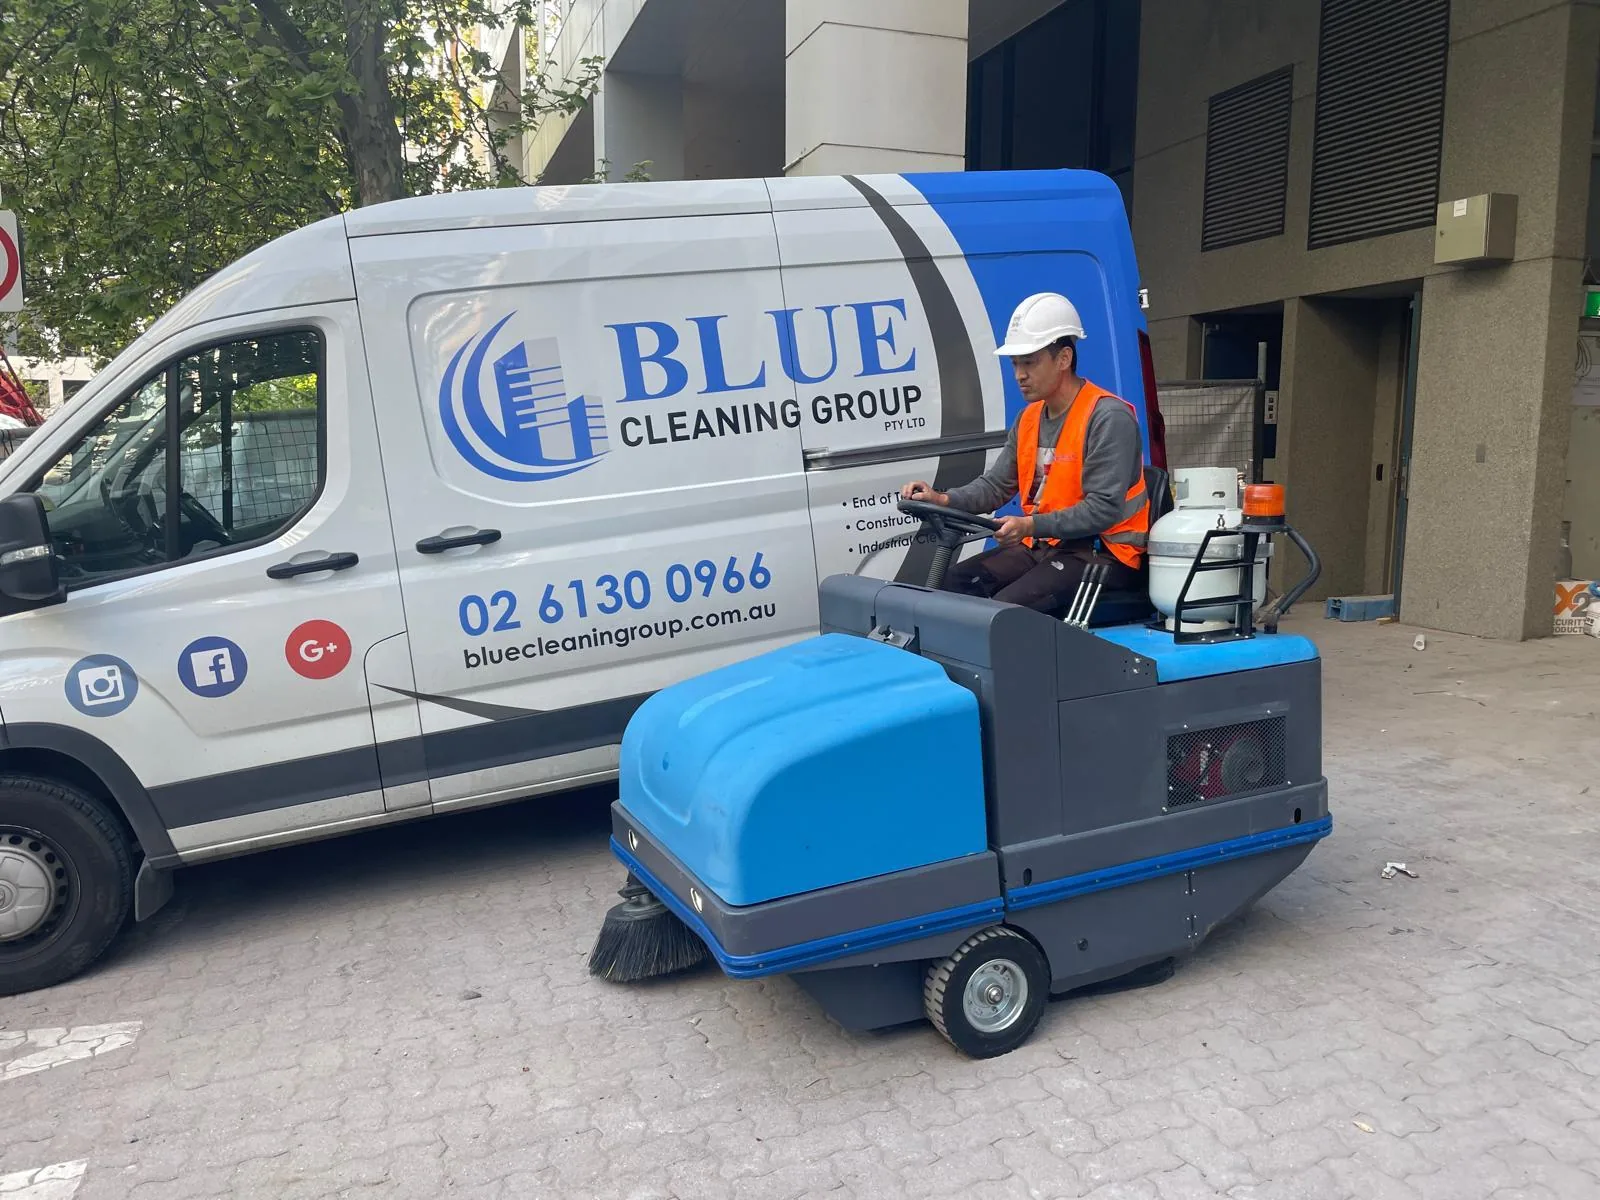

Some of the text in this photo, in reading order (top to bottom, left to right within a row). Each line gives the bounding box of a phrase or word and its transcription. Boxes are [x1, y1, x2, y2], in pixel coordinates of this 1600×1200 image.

[603, 298, 917, 403] BLUE
[619, 385, 922, 448] CLEANING GROUP
[884, 417, 926, 431] PTY LTD
[853, 495, 876, 509] End
[879, 492, 892, 505] of
[858, 535, 913, 554] Industrial
[458, 551, 771, 637] 02 6130 0966
[1552, 583, 1589, 617] X2
[463, 602, 777, 669] bluecleaningroup.com.au
